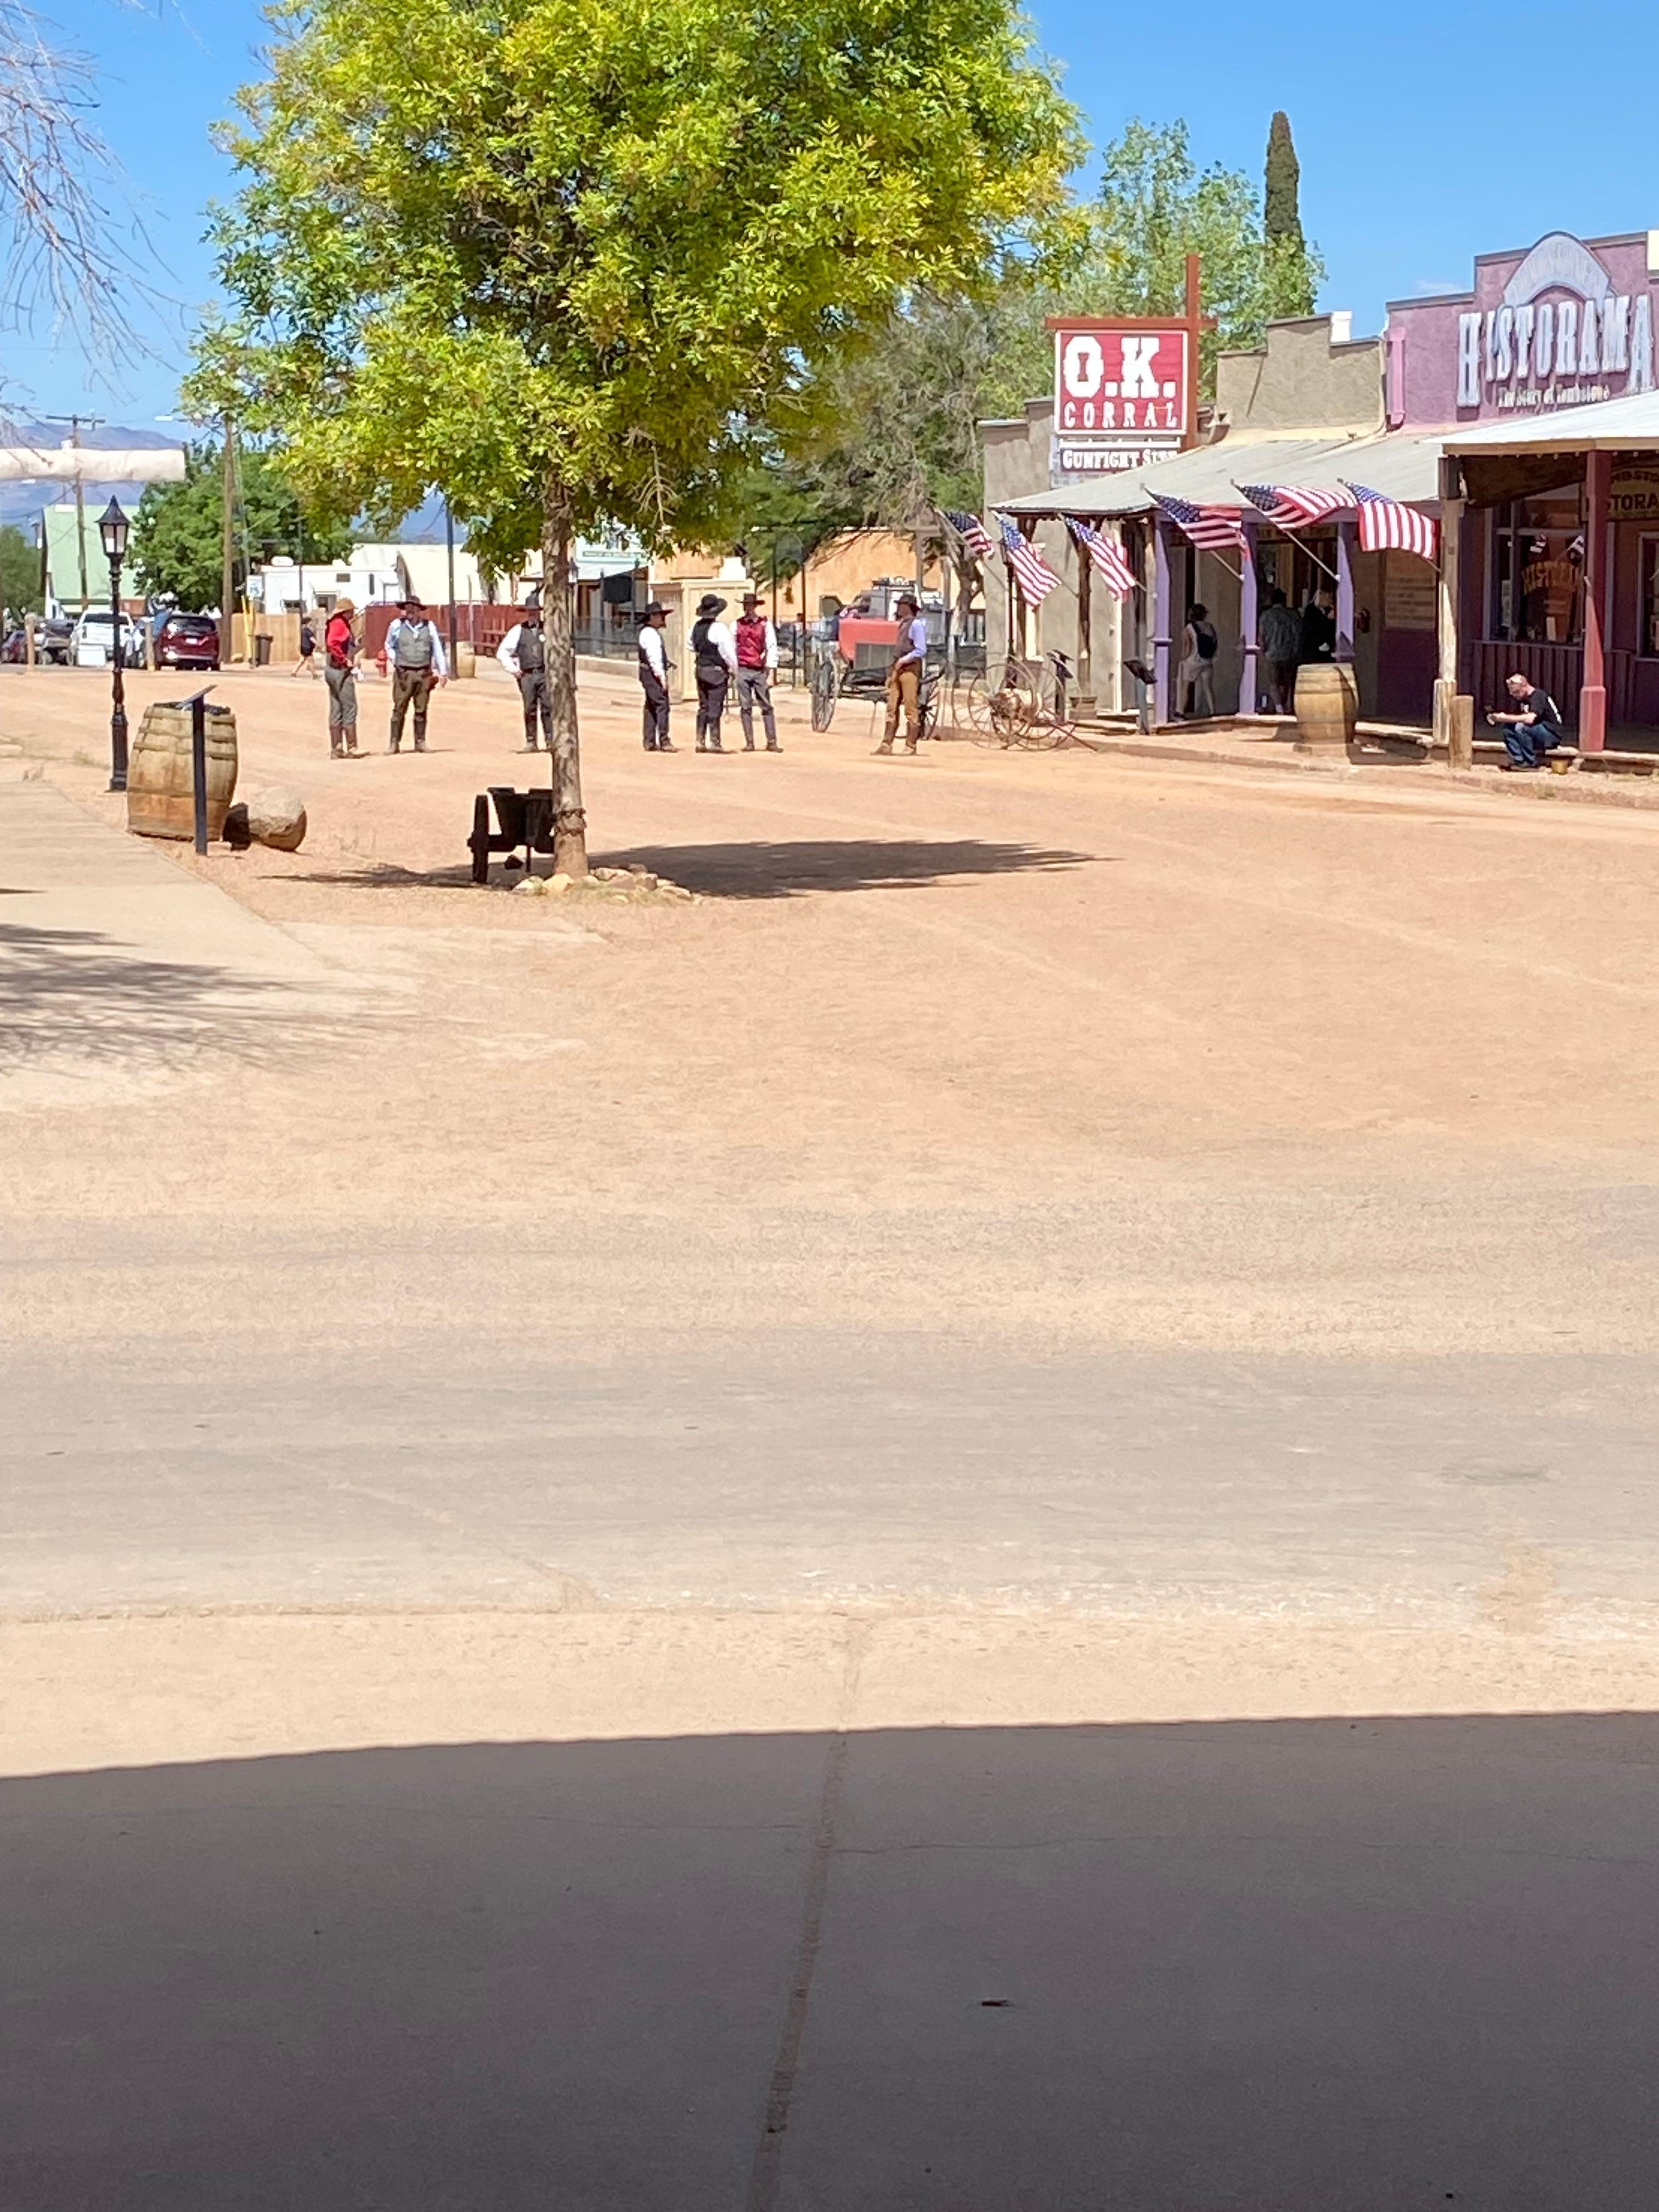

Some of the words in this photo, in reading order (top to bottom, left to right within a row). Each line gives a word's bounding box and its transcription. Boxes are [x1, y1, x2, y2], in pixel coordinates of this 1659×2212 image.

[1063, 336, 1176, 398] O.K.
[1457, 295, 1654, 408] HISTORAMA
[1064, 402, 1177, 428] CORRAL
